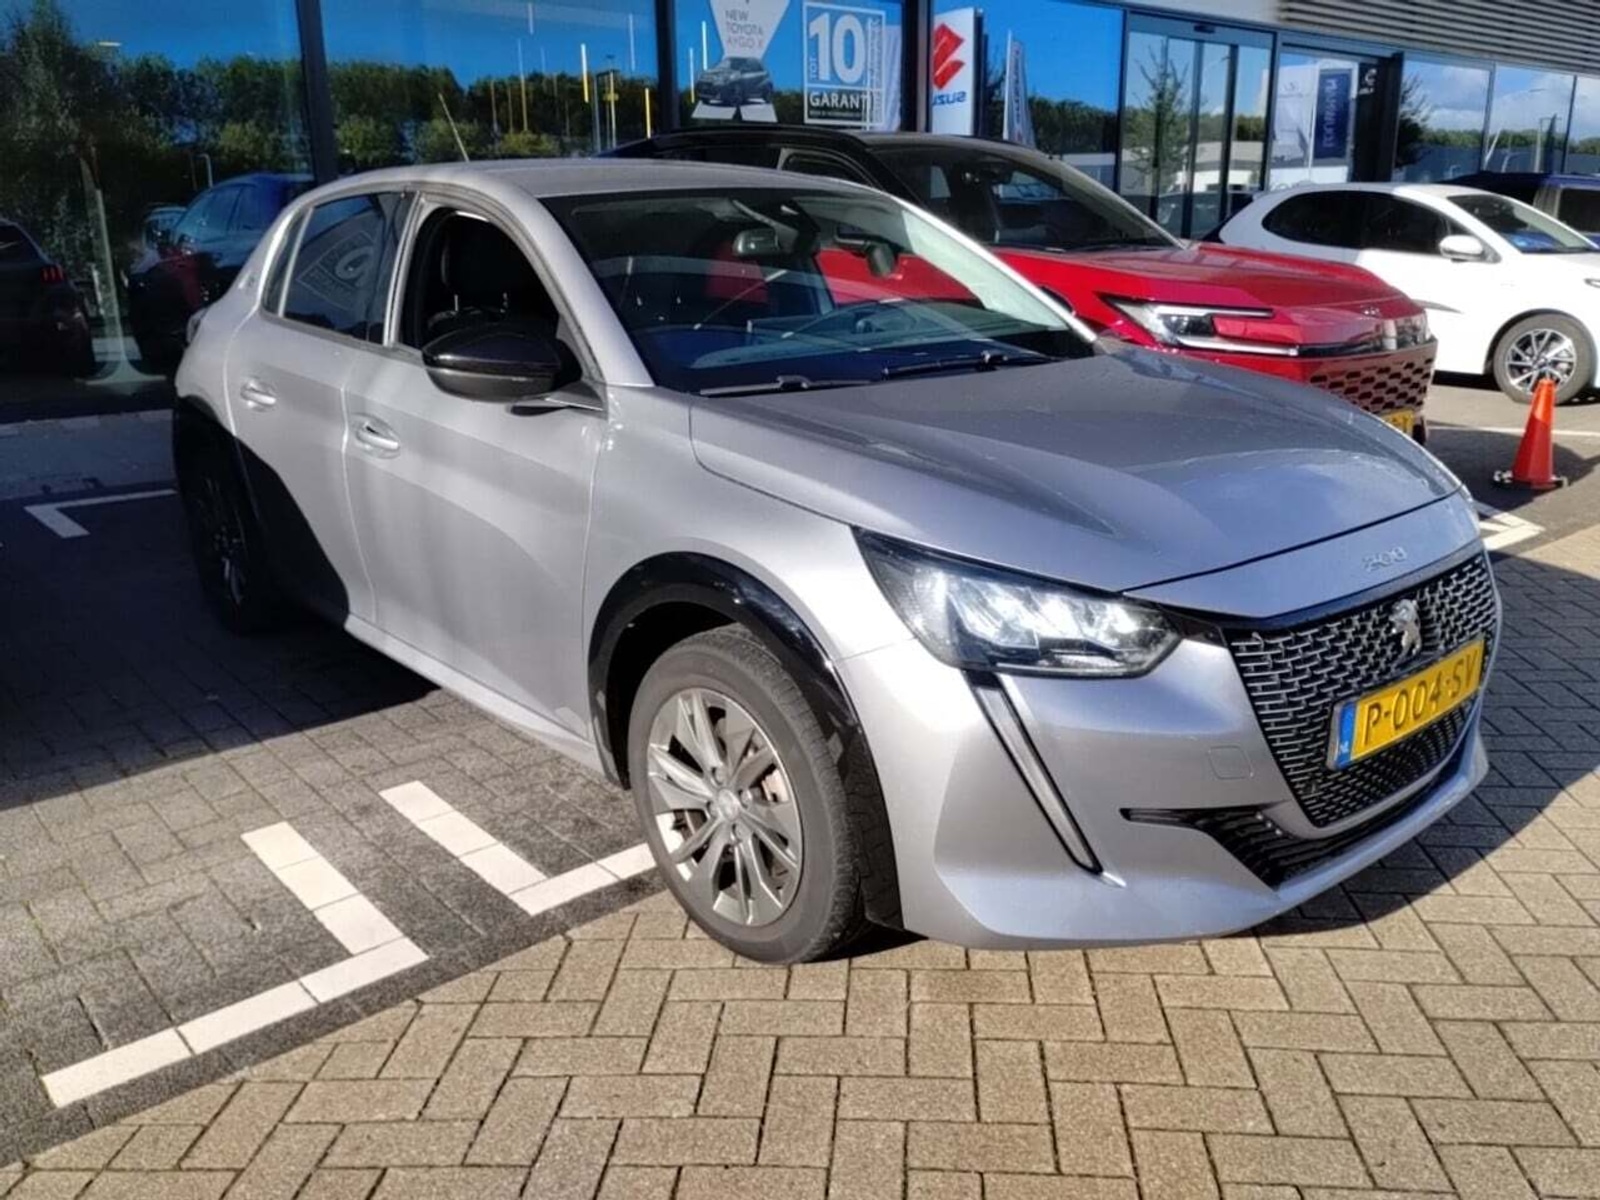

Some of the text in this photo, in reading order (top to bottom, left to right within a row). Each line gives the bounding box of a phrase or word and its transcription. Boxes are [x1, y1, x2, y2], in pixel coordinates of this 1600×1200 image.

[725, 9, 749, 21] NEW
[726, 21, 764, 36] TOYOTA
[809, 12, 865, 84] 10
[809, 90, 880, 110] GARANT
[1362, 649, 1478, 746] P-004-SV
